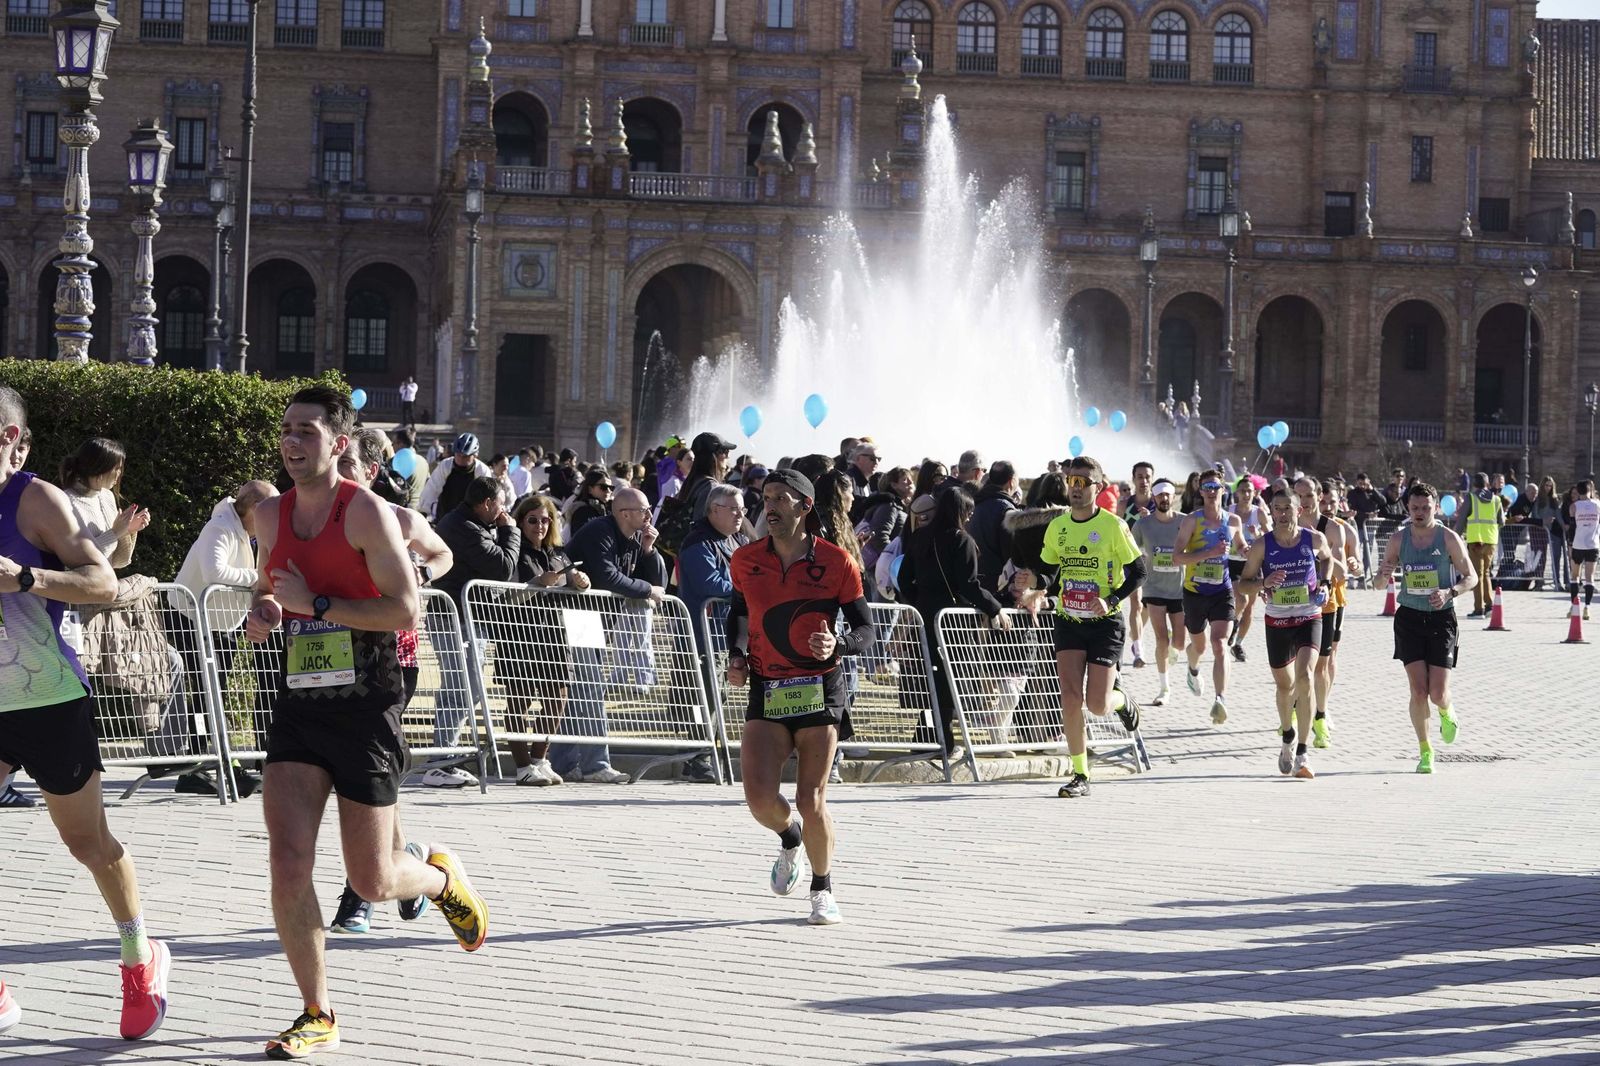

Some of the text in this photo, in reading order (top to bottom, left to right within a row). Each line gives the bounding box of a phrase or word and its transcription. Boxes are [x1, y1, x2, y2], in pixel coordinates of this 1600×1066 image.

[1065, 599, 1089, 609] V.SOLB
[306, 642, 324, 651] 1756
[301, 655, 333, 671] JACK
[784, 691, 802, 700] 1583
[764, 702, 824, 717] PAULO CASTRO
